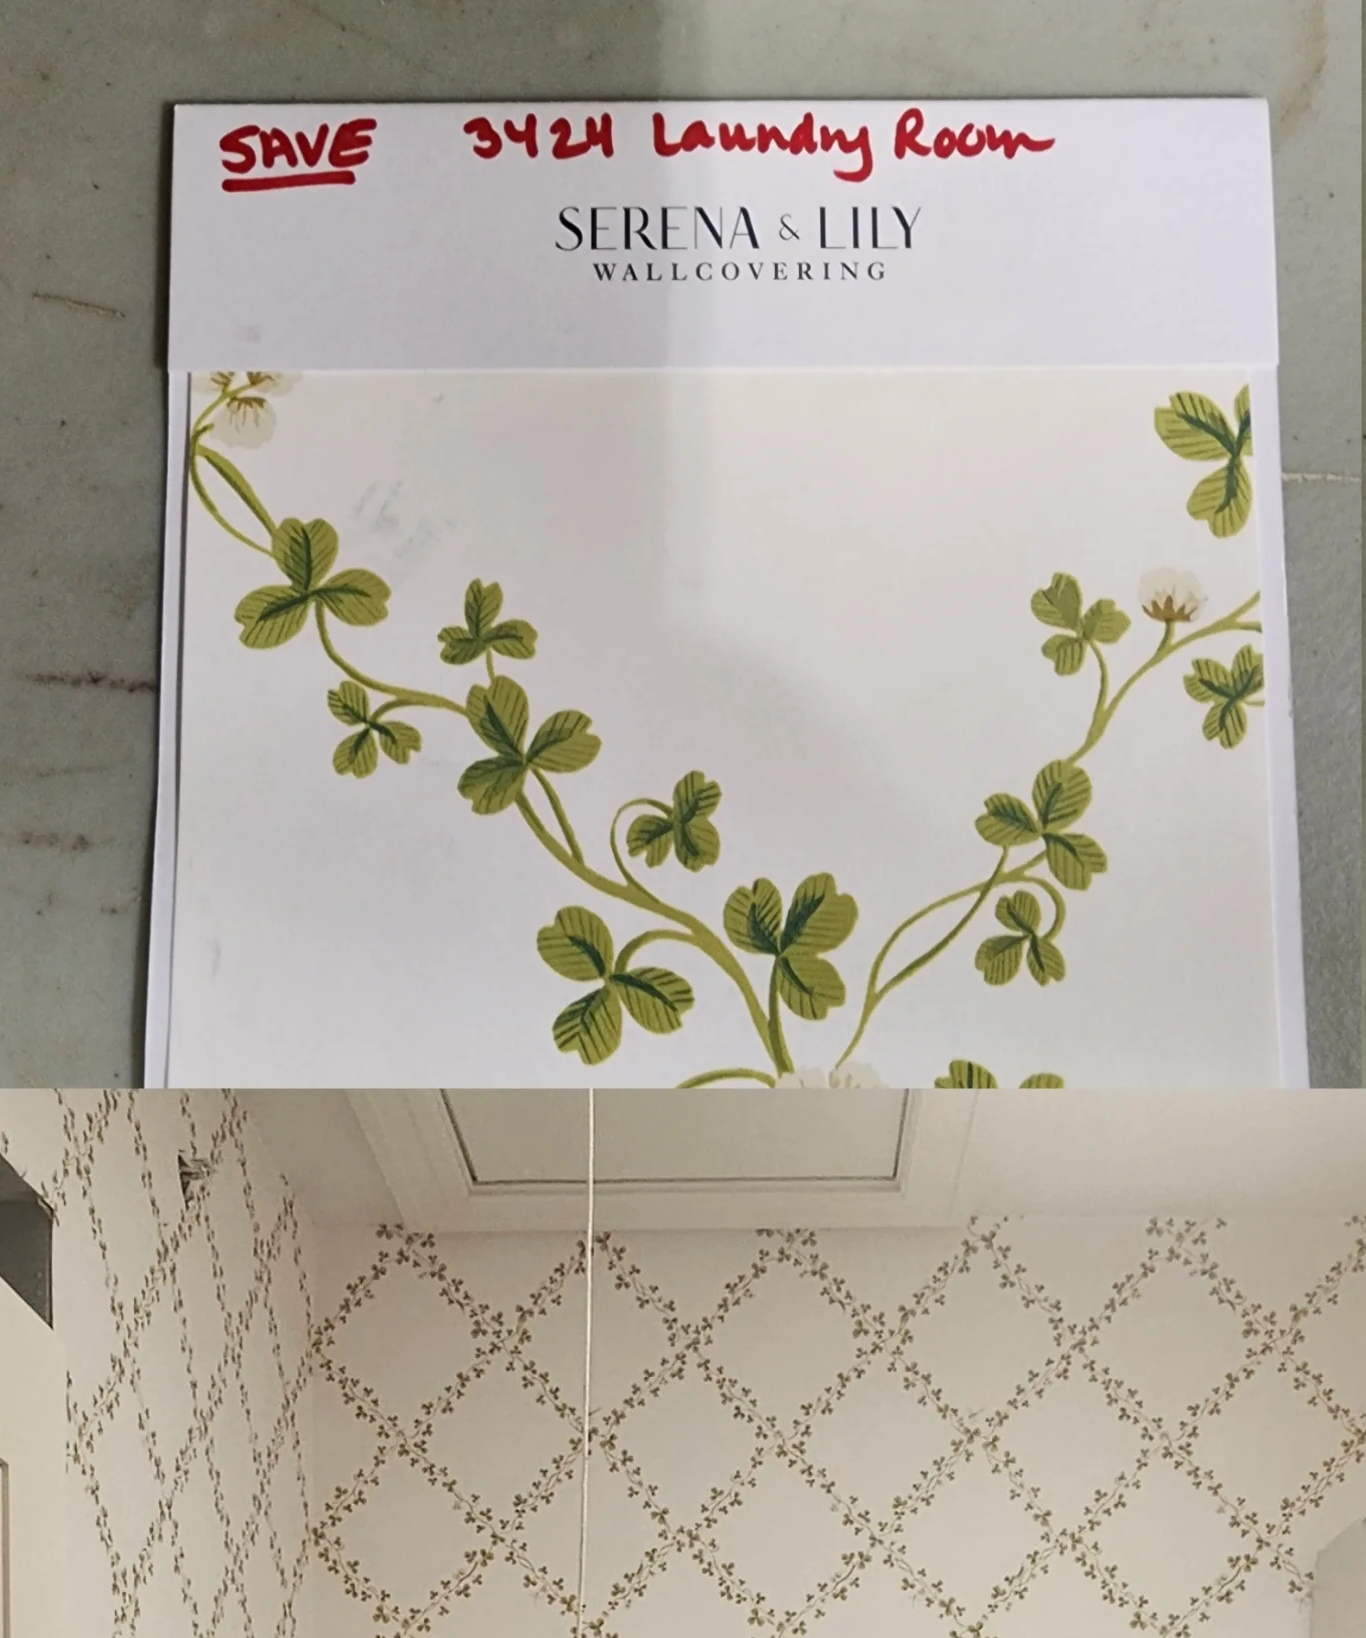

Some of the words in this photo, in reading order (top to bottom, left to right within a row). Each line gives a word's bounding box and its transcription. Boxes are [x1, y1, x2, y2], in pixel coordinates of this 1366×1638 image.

[219, 117, 376, 175] SAVE
[464, 114, 614, 160] 3424
[653, 112, 873, 183] Laundry
[894, 107, 1055, 160] Room
[555, 205, 760, 252] SERENA
[779, 213, 800, 241] &
[819, 205, 922, 250] LILY
[593, 261, 885, 282] WALLCOVERING
